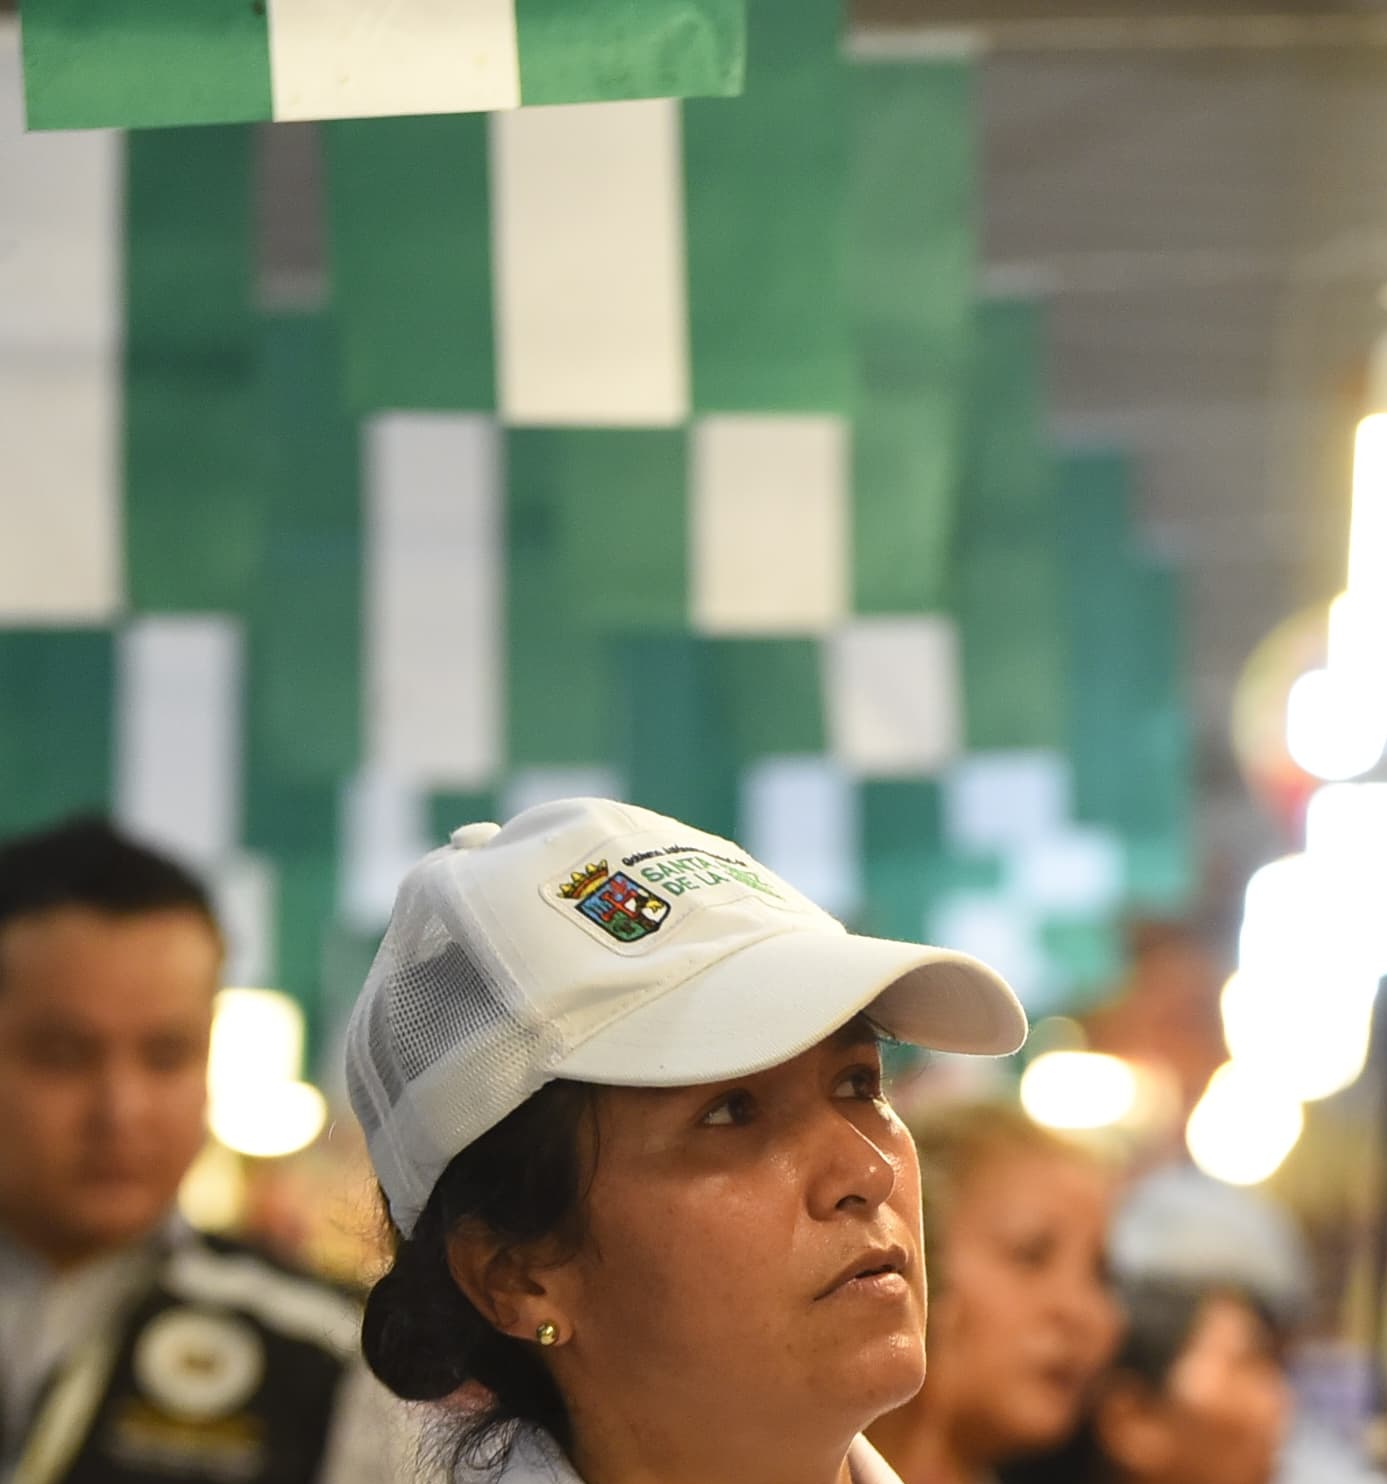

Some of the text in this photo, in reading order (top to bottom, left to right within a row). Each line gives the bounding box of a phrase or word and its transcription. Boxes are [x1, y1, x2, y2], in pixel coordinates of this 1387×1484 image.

[641, 856, 711, 882] SANTA
[662, 876, 700, 896] DE
[694, 871, 730, 886] LA
